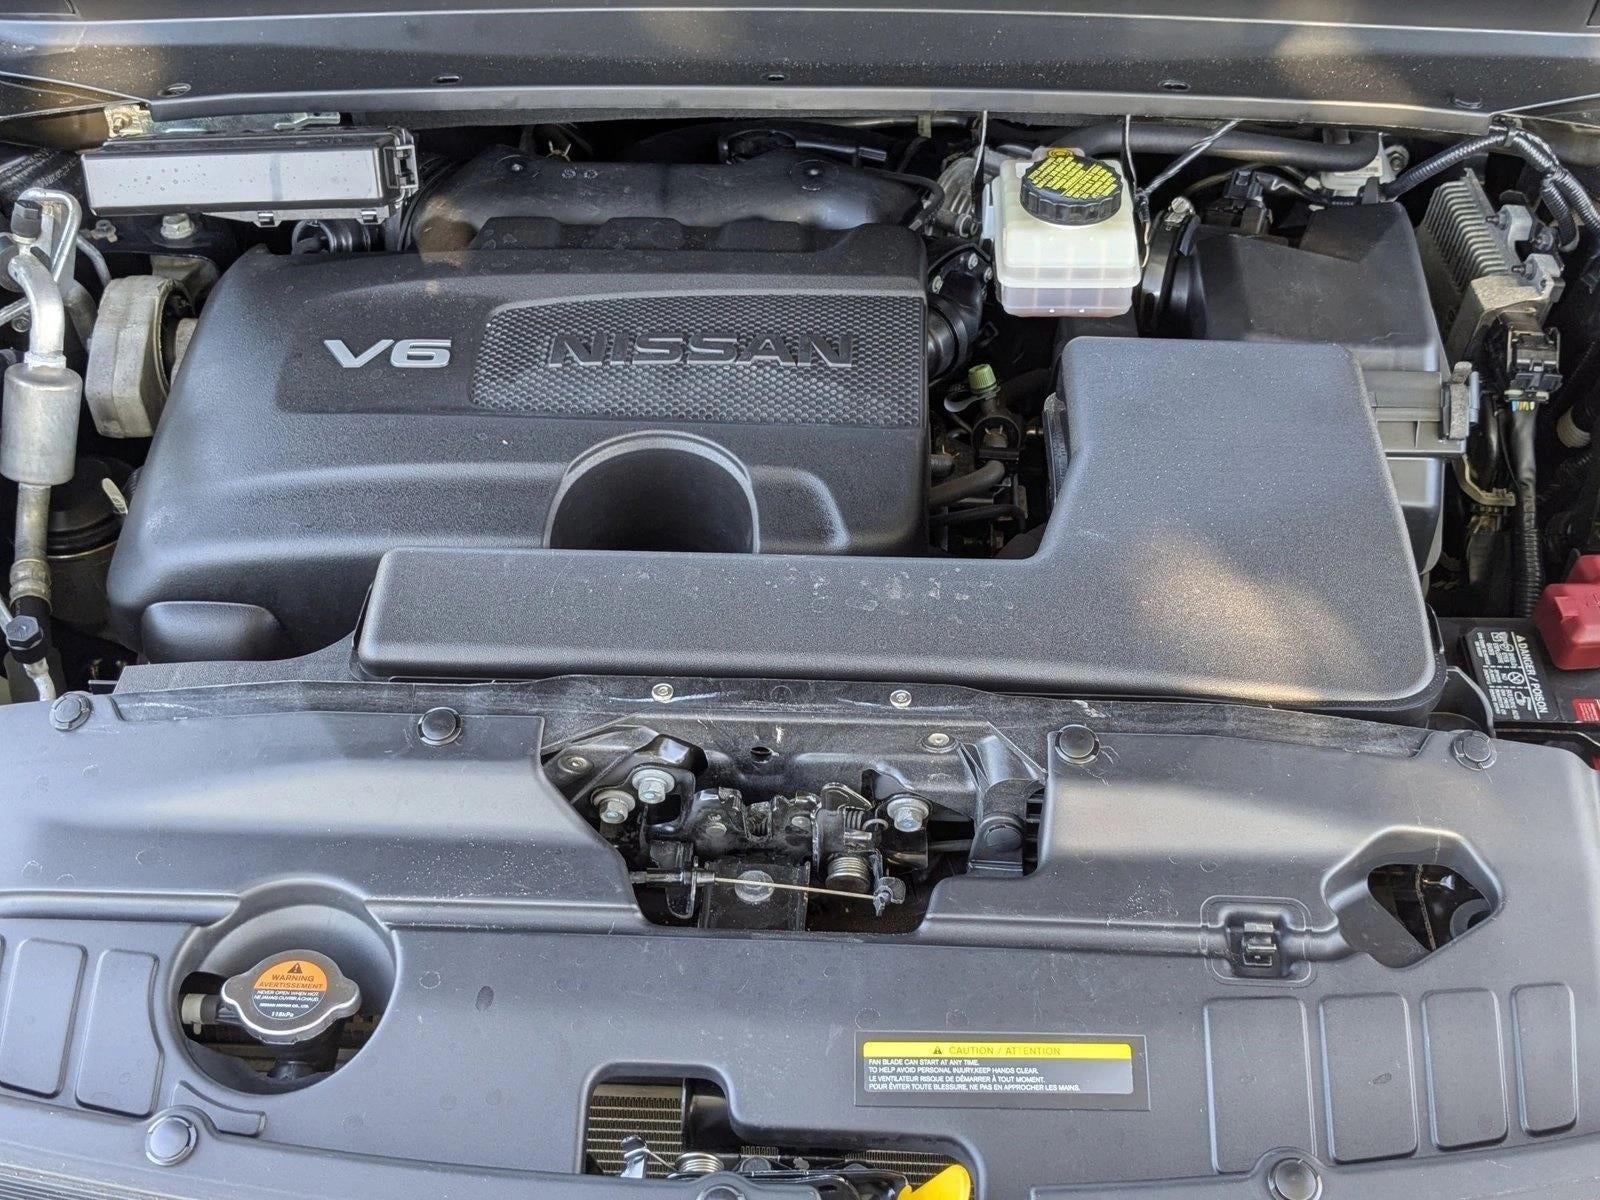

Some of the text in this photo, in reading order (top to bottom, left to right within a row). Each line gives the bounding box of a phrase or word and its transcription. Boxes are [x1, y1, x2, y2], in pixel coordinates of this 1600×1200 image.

[323, 338, 452, 368] V6
[547, 332, 853, 367] NISSAN
[1519, 641, 1536, 675] DANGER
[1531, 683, 1549, 713] POISON
[949, 1046, 994, 1055] CAUTION
[1005, 1046, 1061, 1055] ATTENTION
[920, 1075, 944, 1083] RISQUE
